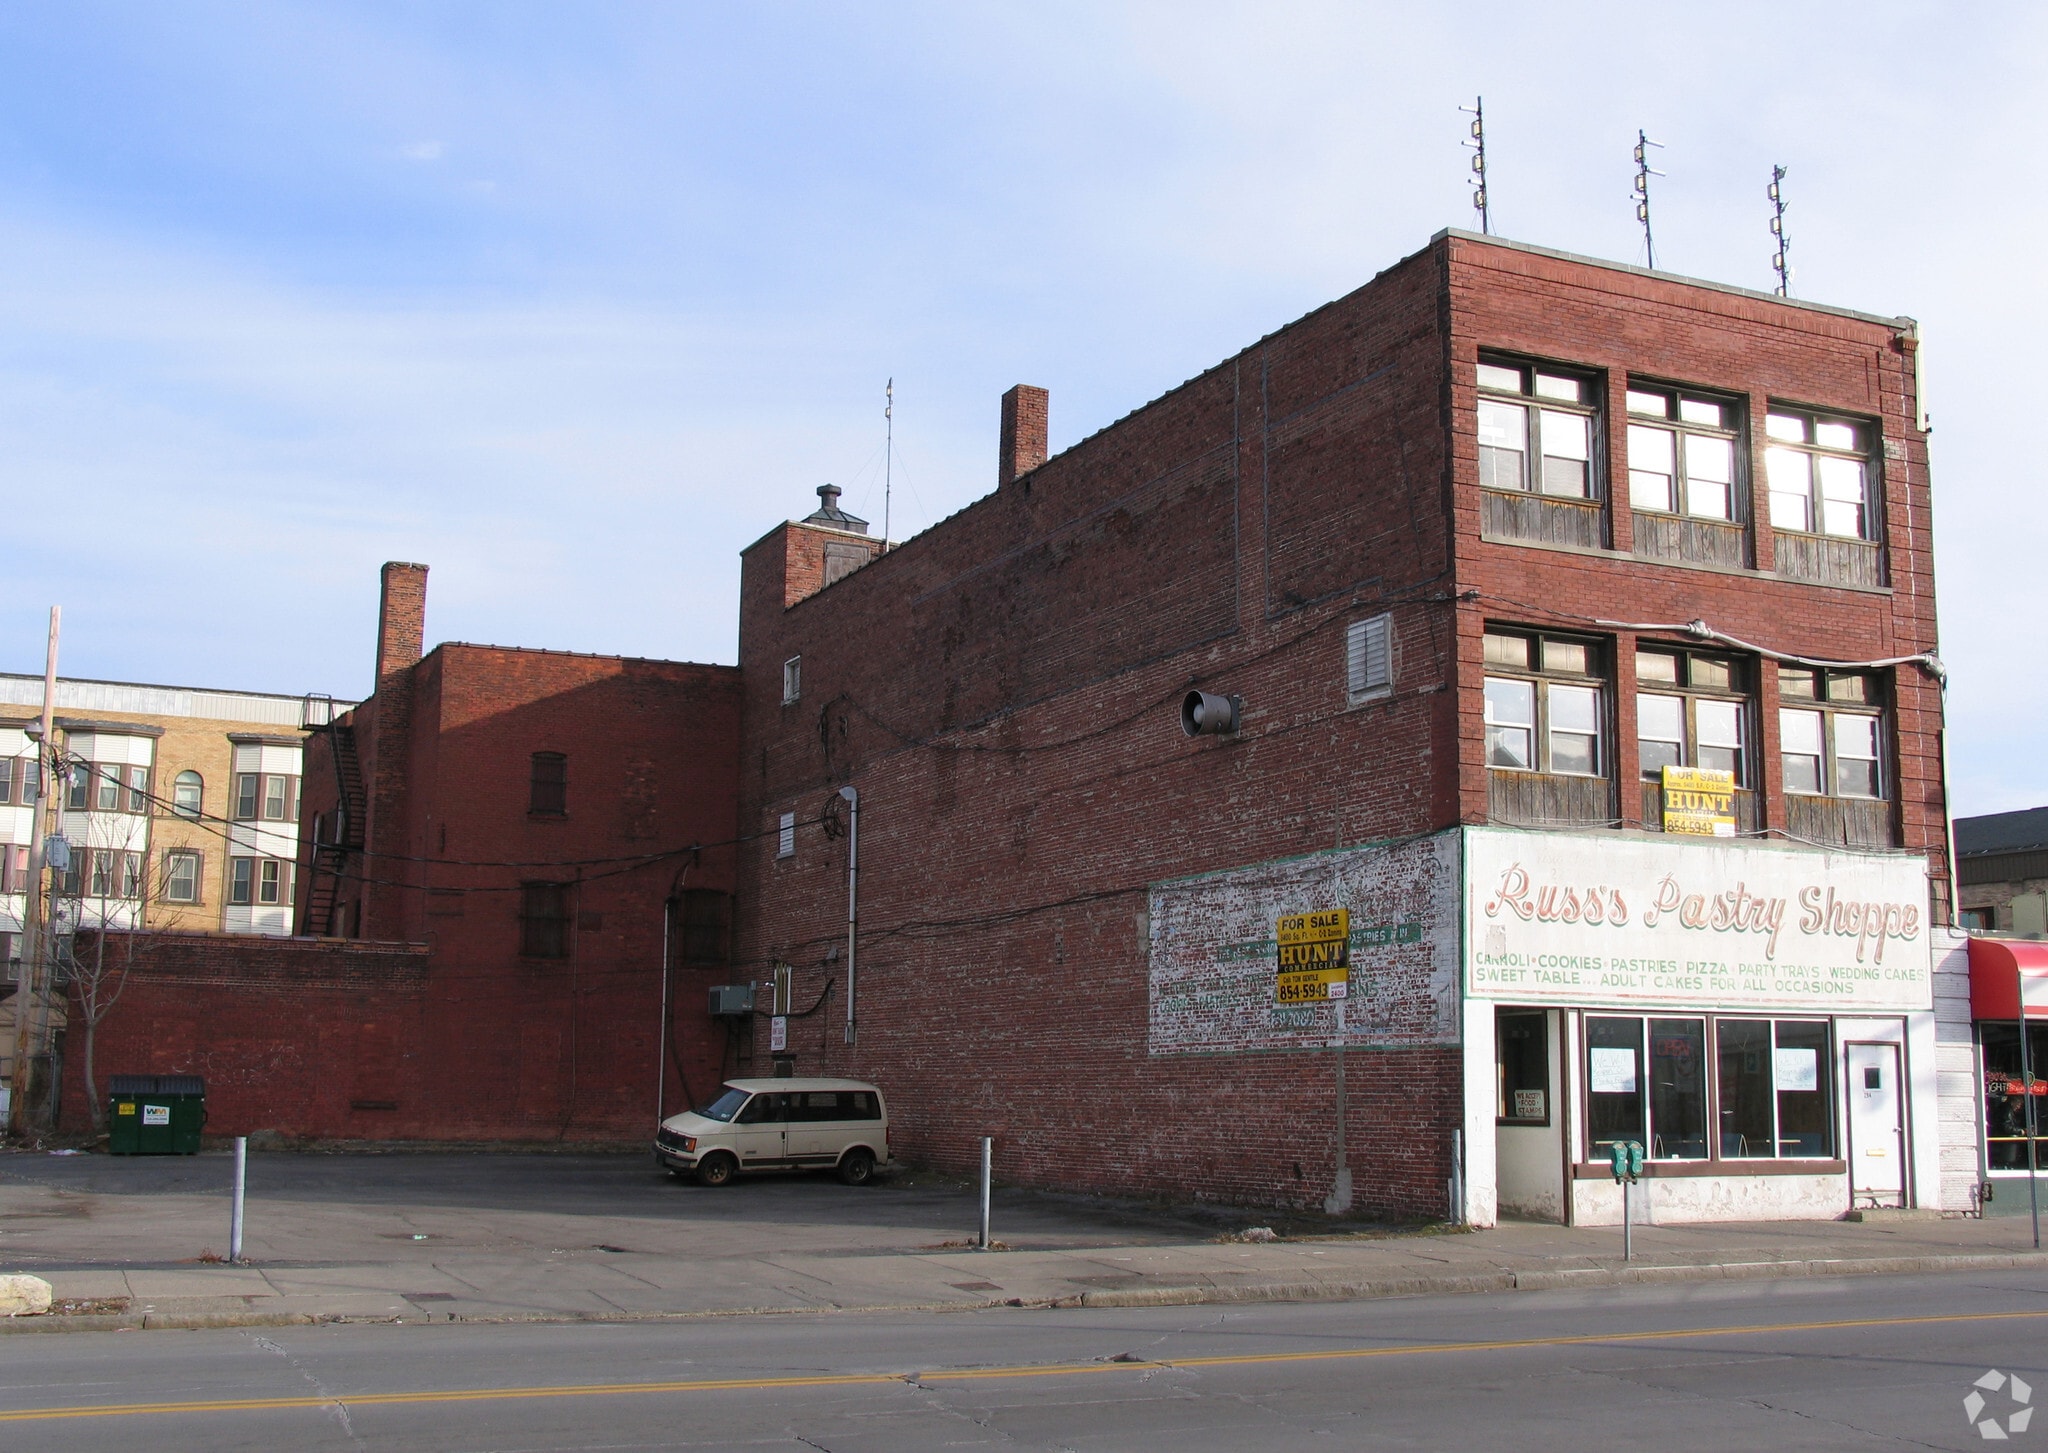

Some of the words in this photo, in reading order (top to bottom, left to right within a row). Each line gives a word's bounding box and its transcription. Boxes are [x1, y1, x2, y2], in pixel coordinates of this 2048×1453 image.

[1669, 771, 1693, 781] FOR
[1699, 772, 1729, 783] SALE
[1666, 790, 1732, 812] HUNT
[1281, 918, 1305, 931] FOR
[1310, 914, 1339, 928] SALE
[1485, 861, 1630, 927] Russ's
[1644, 871, 1787, 960] Pastry
[1799, 885, 1920, 965] Shoppe
[1279, 941, 1344, 965] HUNT
[1284, 961, 1338, 973] COMMERCIAL
[1475, 952, 1530, 967] CANNOLI
[1538, 954, 1602, 970] COOKIES
[1611, 958, 1677, 973] PASTRIES
[1686, 961, 1728, 975] PIZZA
[1738, 963, 1777, 978] PARTY
[1781, 965, 1820, 979] TRAYS
[1828, 966, 1880, 981] WEDDING
[1884, 968, 1925, 982] CAKES
[1476, 967, 1527, 982] SWEET
[1600, 973, 1647, 988] ADULT
[1653, 976, 1703, 990] CAKES
[1710, 977, 1737, 991] FOR
[1742, 980, 1767, 991] ALL
[1774, 980, 1854, 994] OCCASIONS
[1655, 1038, 1691, 1057] OPEN
